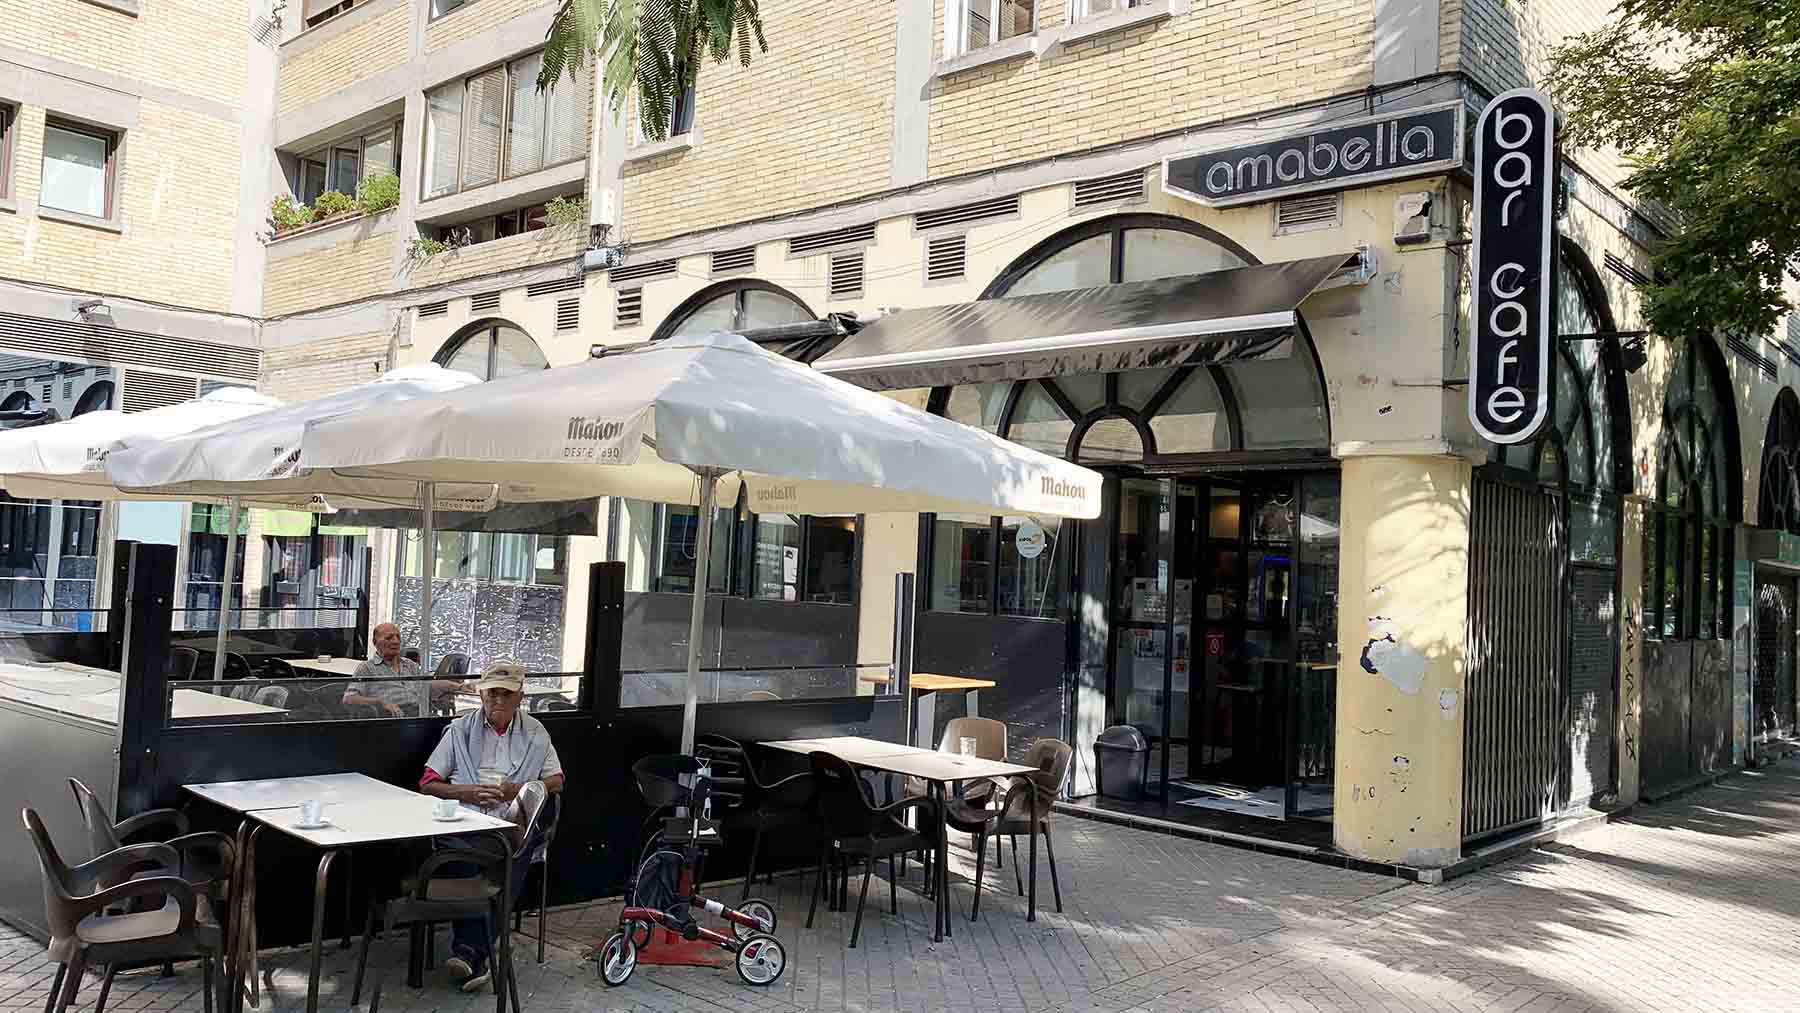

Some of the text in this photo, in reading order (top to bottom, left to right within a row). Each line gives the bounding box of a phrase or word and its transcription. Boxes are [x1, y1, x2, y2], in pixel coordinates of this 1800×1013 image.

[1206, 120, 1434, 193] amabella
[1488, 107, 1533, 423] bar cafe
[567, 416, 625, 440] Mahou
[1041, 475, 1086, 500] Mahou
